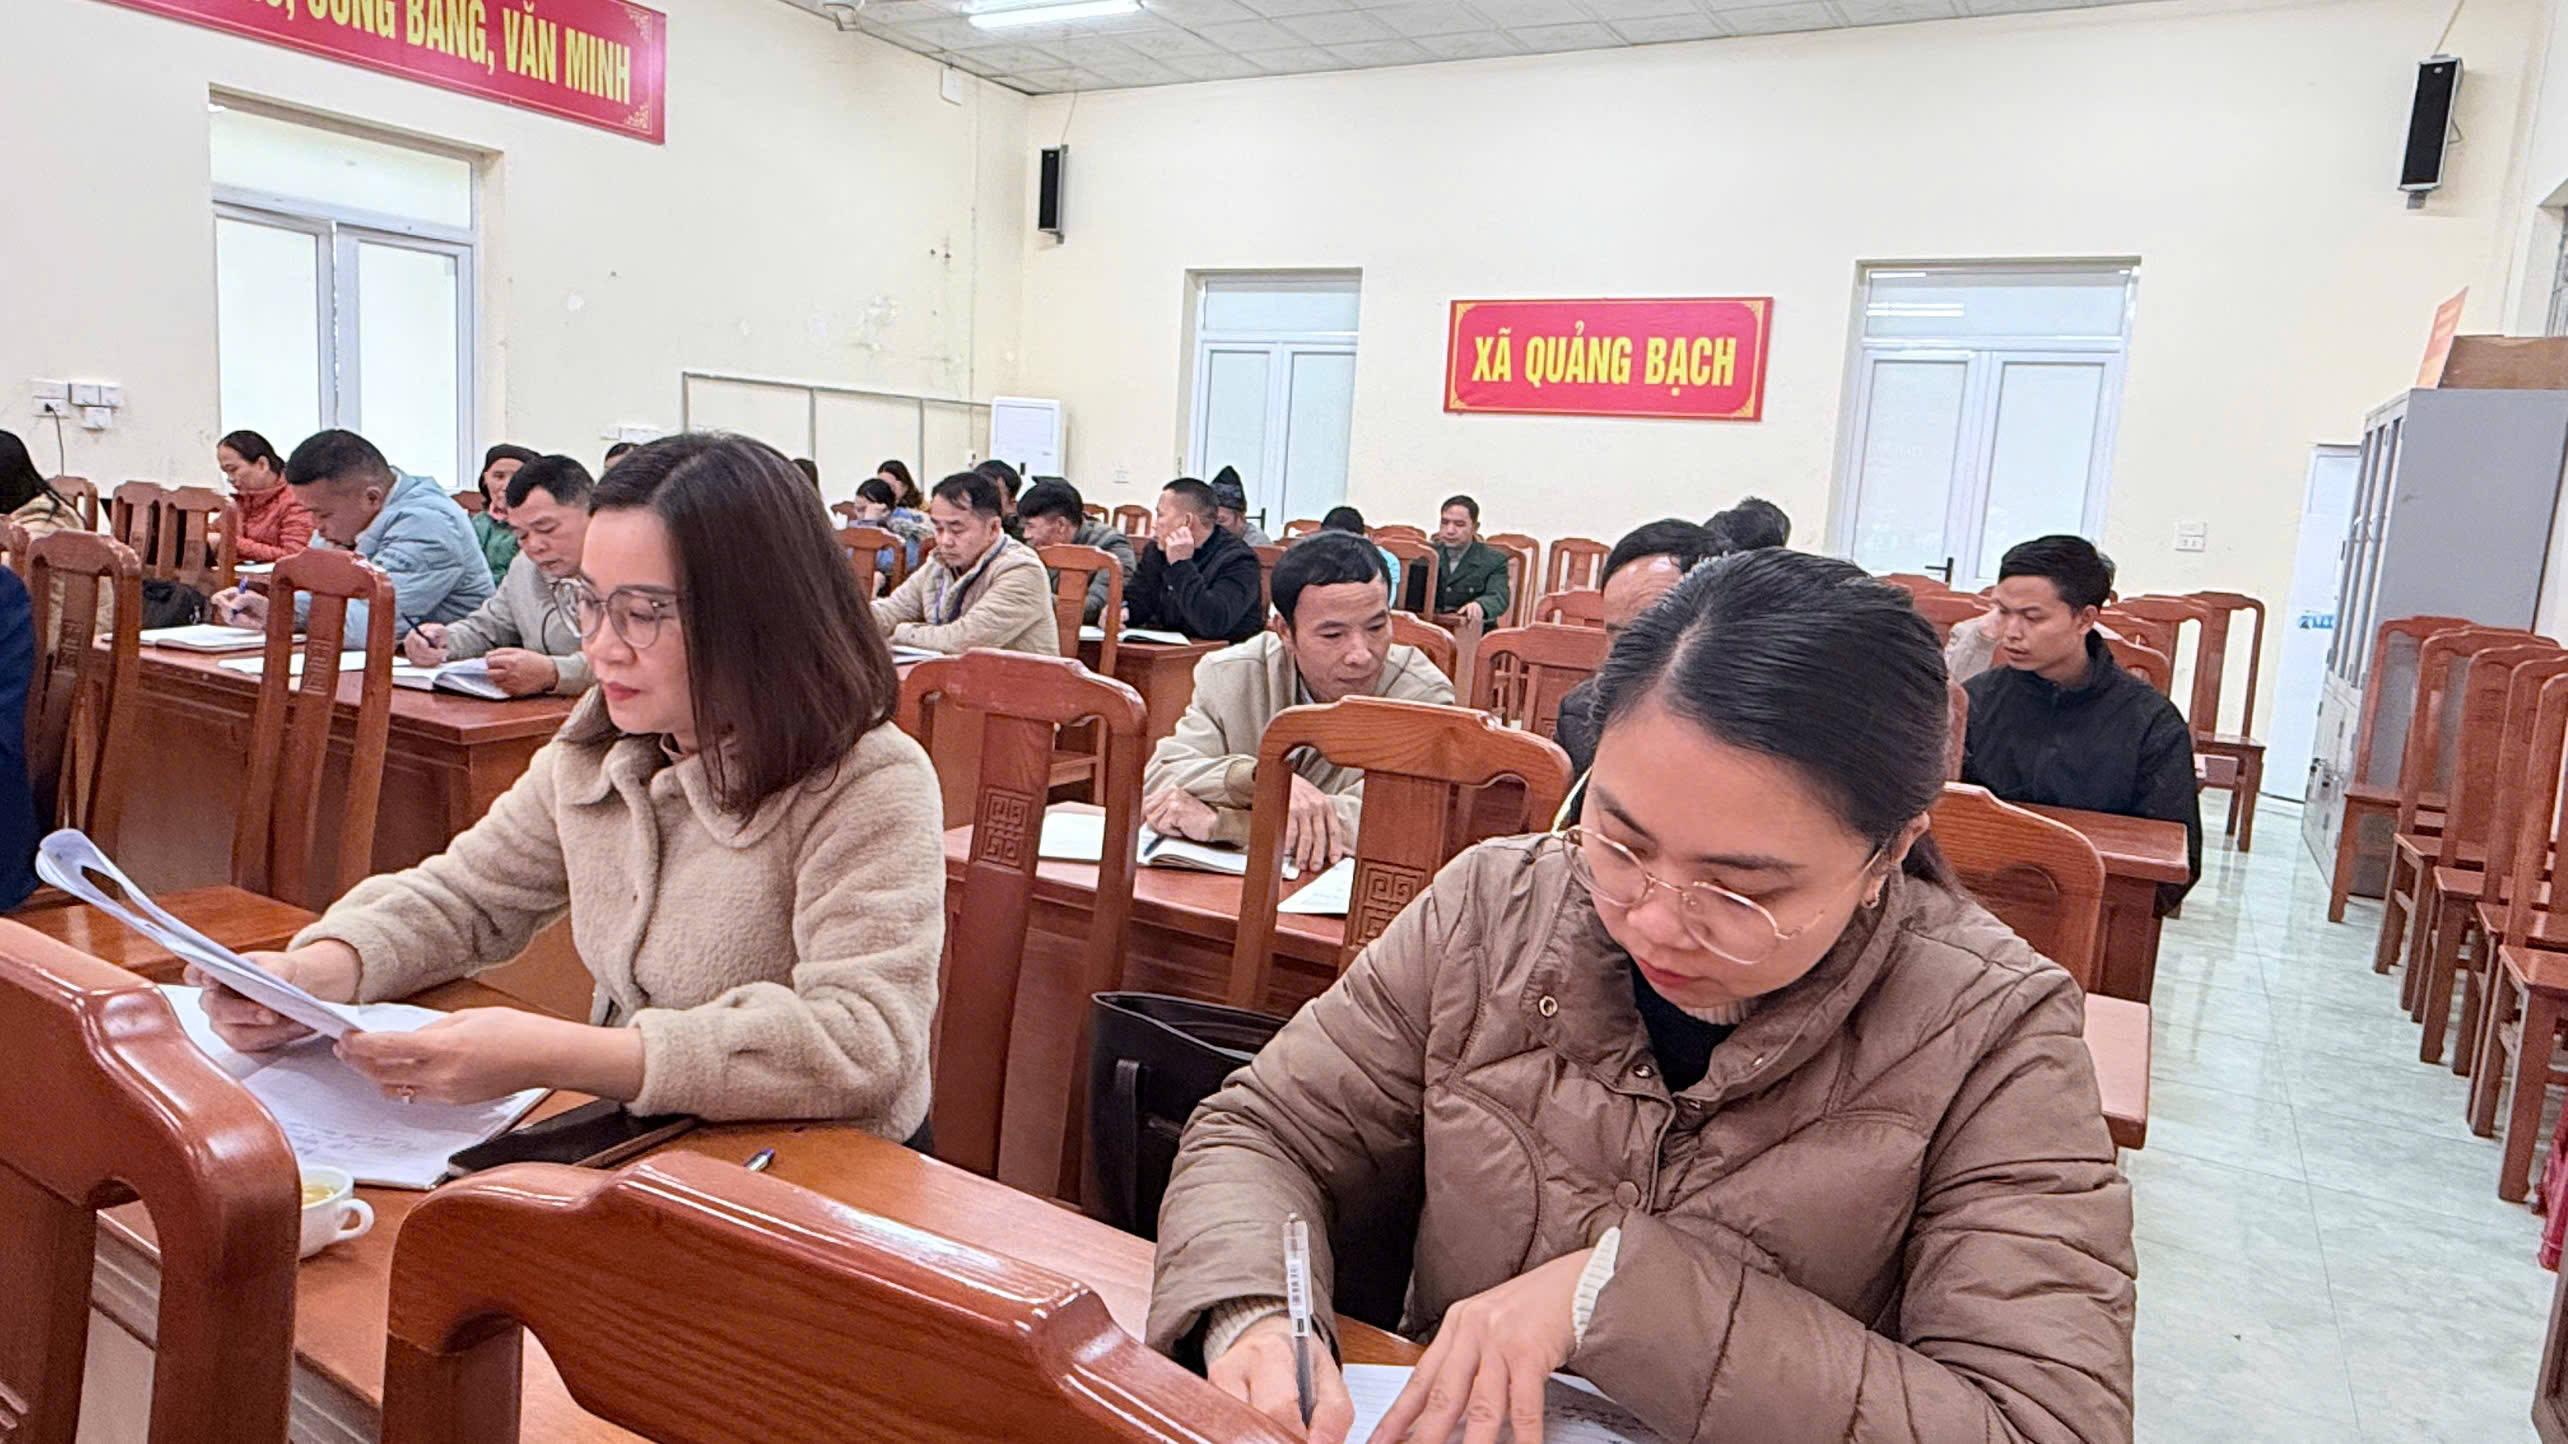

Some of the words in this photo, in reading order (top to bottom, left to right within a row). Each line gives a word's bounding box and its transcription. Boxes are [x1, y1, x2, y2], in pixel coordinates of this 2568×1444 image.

[503, 0, 557, 84] VĂN
[565, 27, 631, 105] MINH
[1472, 327, 1512, 382] XÃ
[1524, 320, 1633, 388] QUẢNG
[1644, 337, 1737, 396] BẠCH
